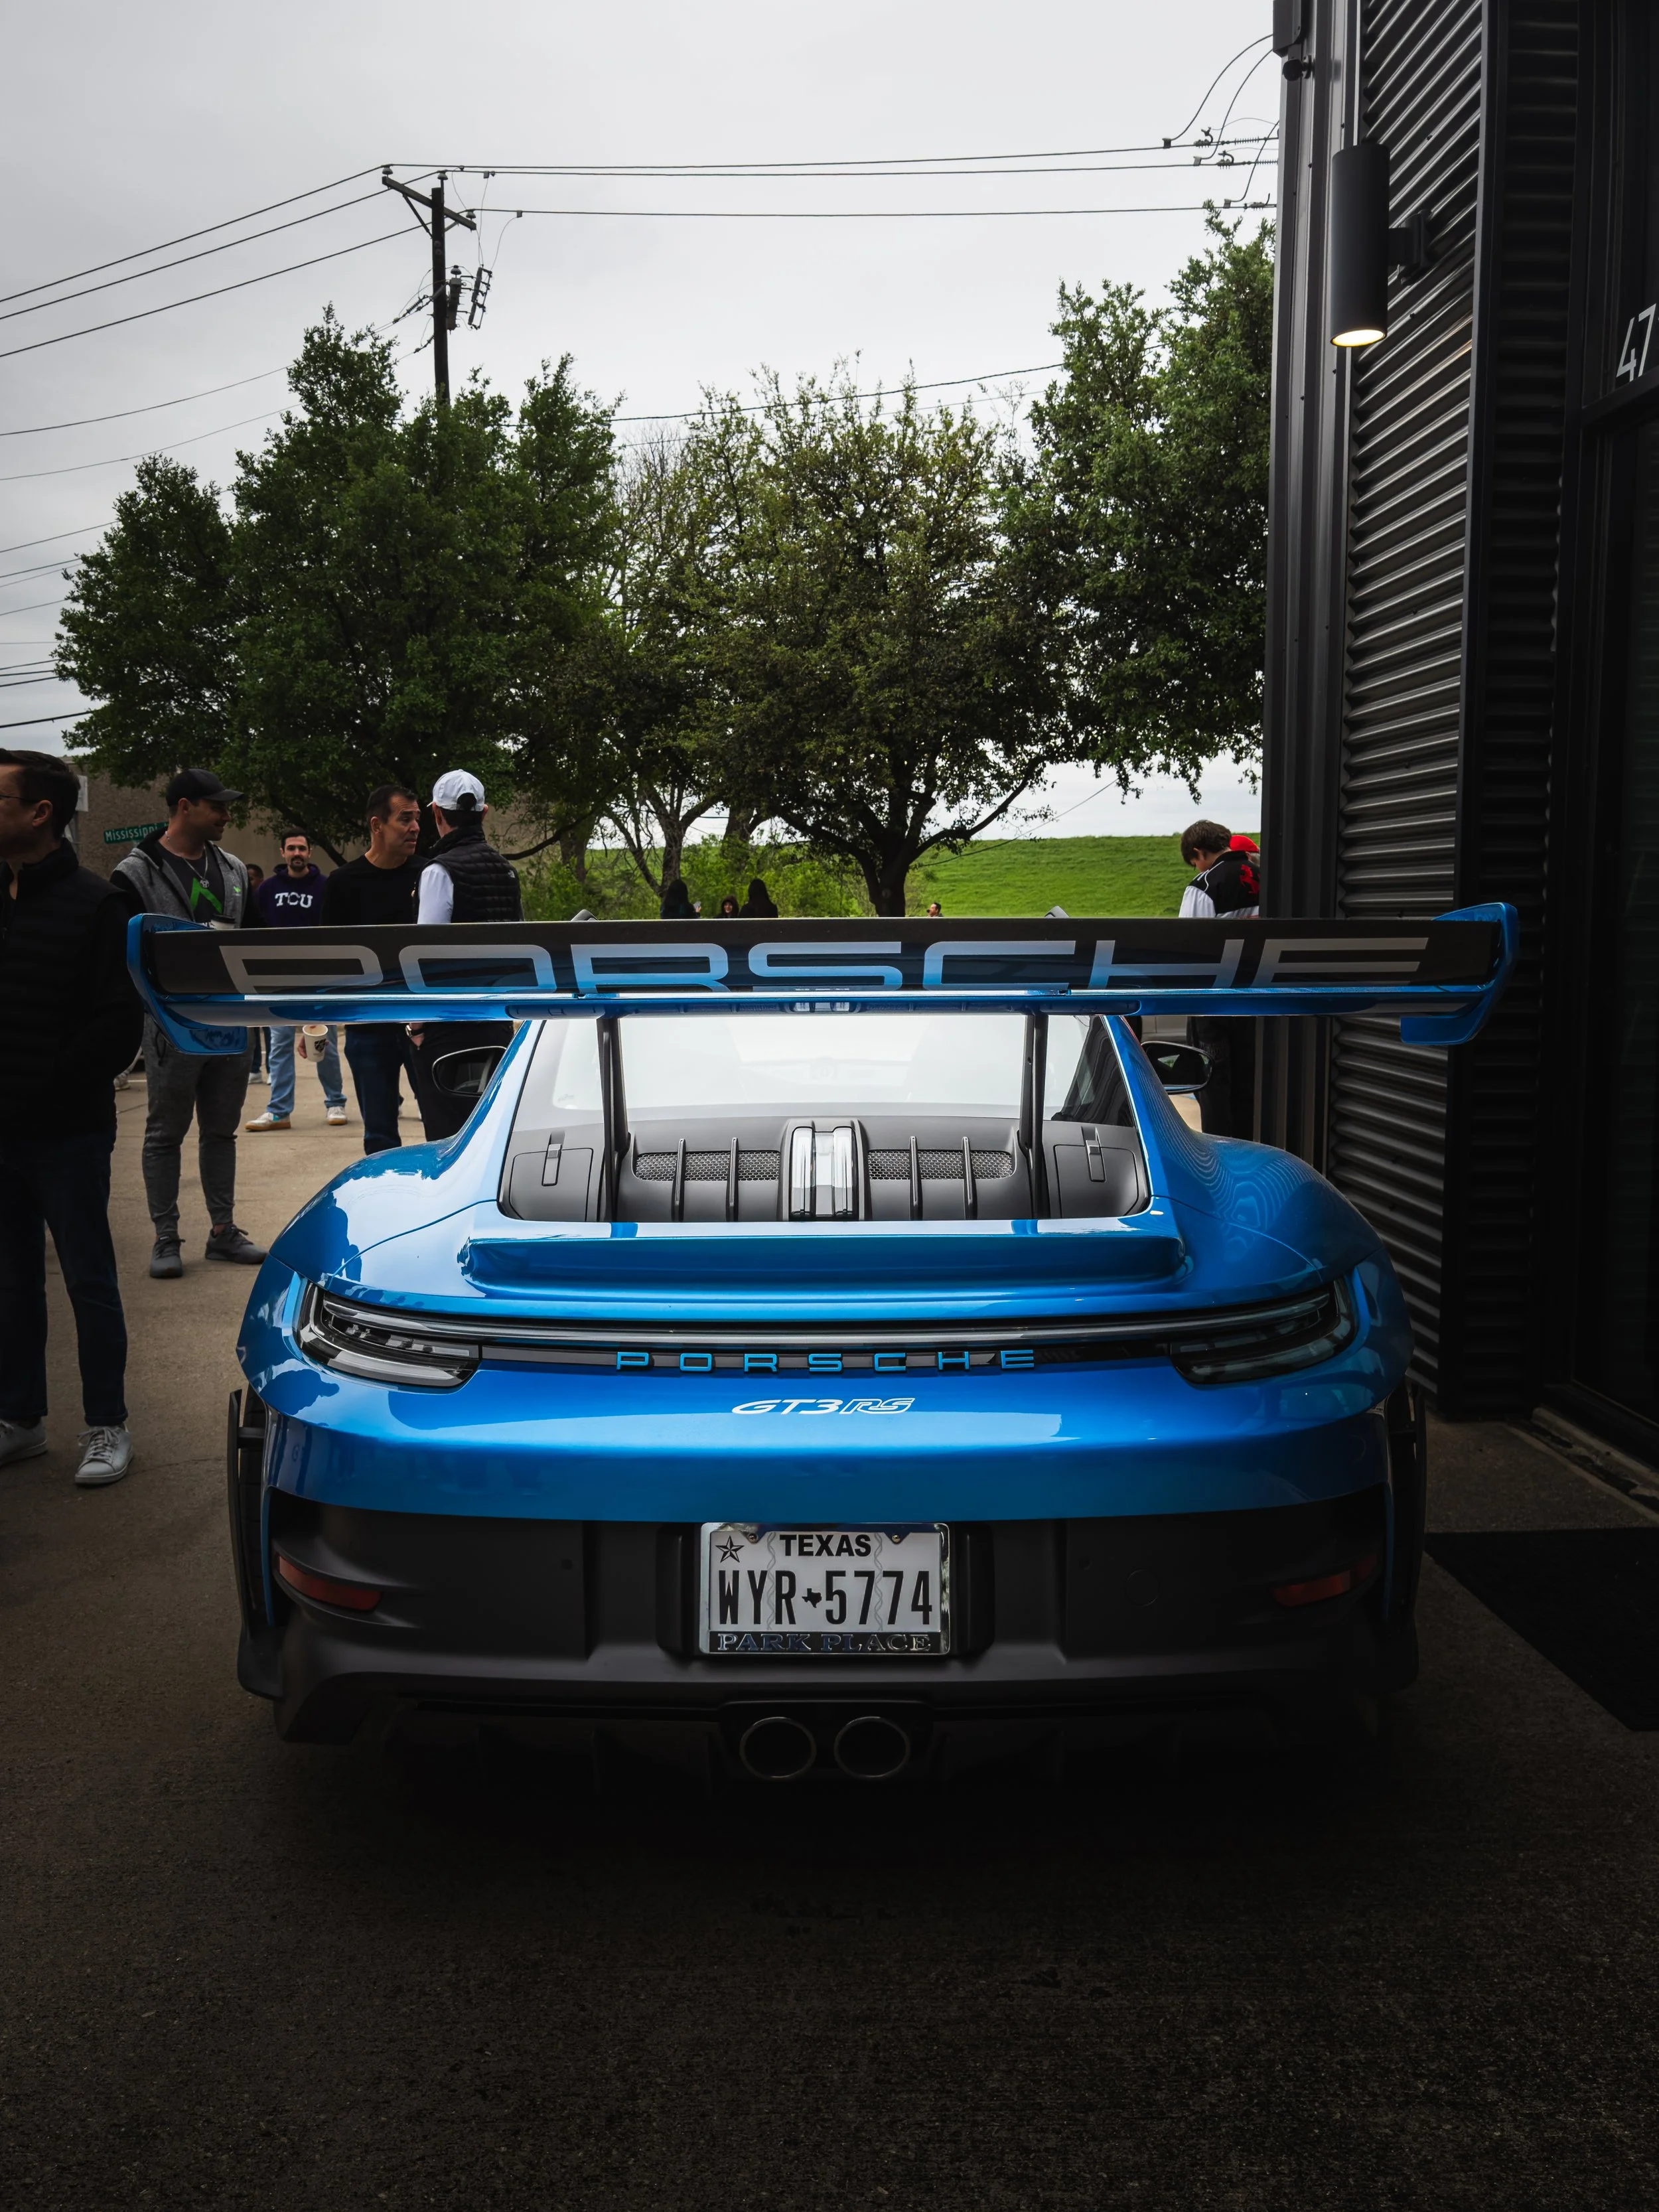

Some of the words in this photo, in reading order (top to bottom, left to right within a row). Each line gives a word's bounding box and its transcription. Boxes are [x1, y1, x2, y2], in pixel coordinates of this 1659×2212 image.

[1617, 303, 1659, 382] 47
[275, 892, 313, 909] TCU
[219, 936, 1429, 995] PORSCHE
[616, 1349, 1035, 1372] PORSCHE
[779, 1534, 871, 1557] TEXAS
[717, 1633, 812, 1652] PARK
[820, 1633, 931, 1652] PLACE
